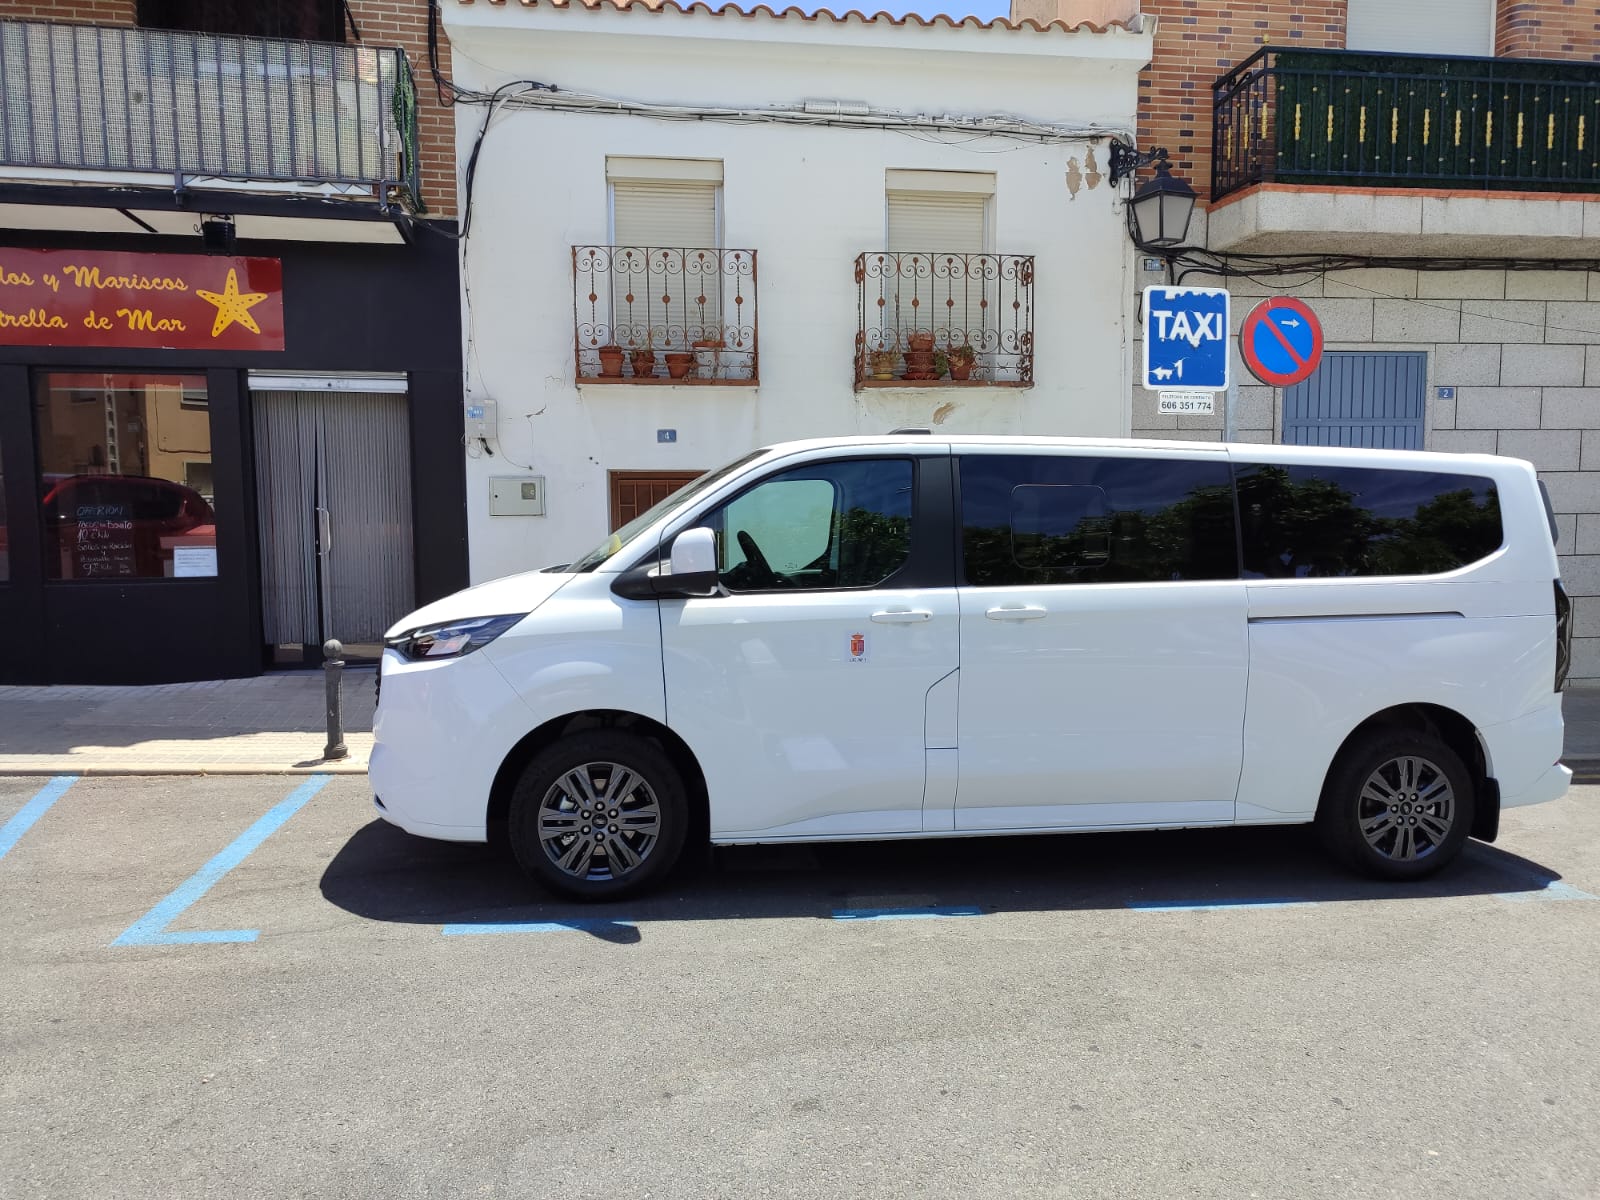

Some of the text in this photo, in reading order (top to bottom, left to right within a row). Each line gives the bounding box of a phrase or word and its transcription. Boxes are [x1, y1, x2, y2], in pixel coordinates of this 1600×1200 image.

[42, 273, 60, 293] y
[63, 264, 189, 291] Mariscos
[84, 310, 114, 330] de
[116, 308, 187, 332] Mar
[1152, 310, 1223, 341] TAXI
[1443, 388, 1449, 398] 2
[1161, 401, 1212, 411] 606 351 774
